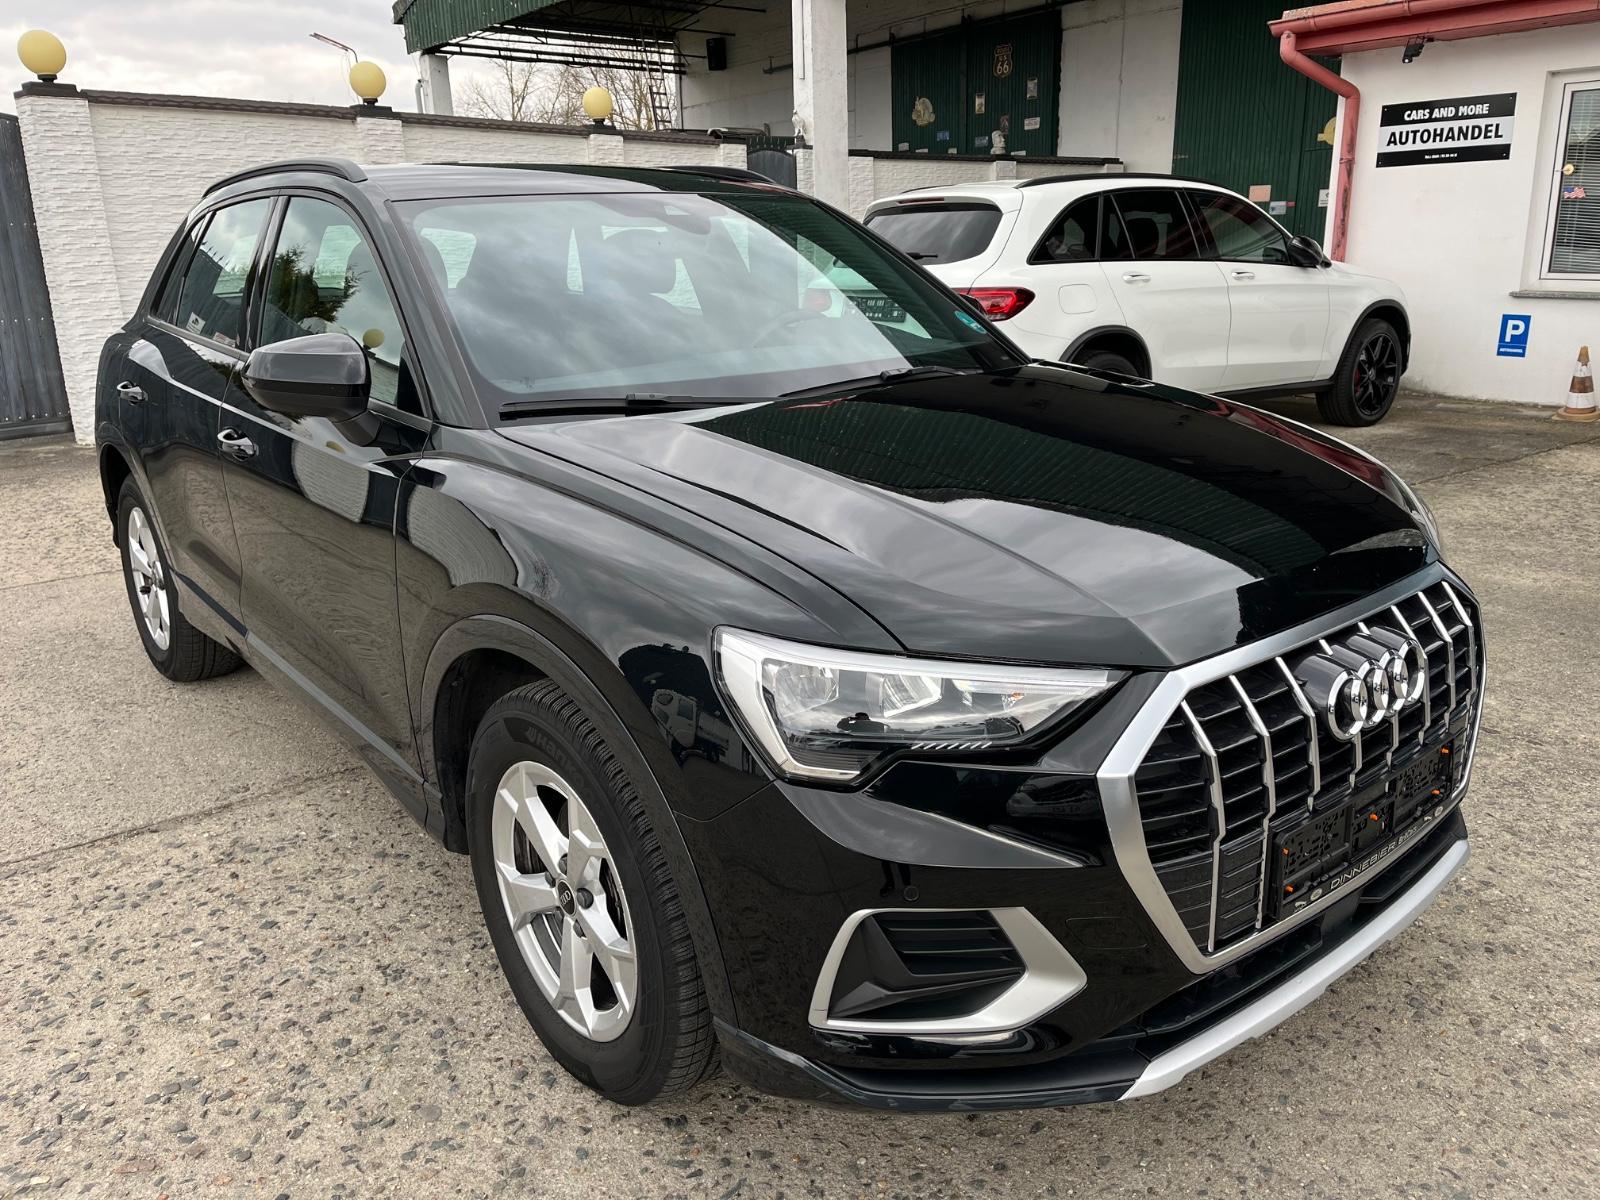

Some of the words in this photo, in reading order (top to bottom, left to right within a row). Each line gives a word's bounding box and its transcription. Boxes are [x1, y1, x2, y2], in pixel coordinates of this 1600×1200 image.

[996, 60, 1009, 74] 66
[1404, 109, 1430, 121] CARS
[1432, 106, 1456, 119] AND
[1458, 103, 1490, 116] MORE
[1386, 123, 1504, 147] AUTOHANDEL
[1504, 319, 1525, 343] P
[1330, 841, 1397, 890] DINNEBIER
